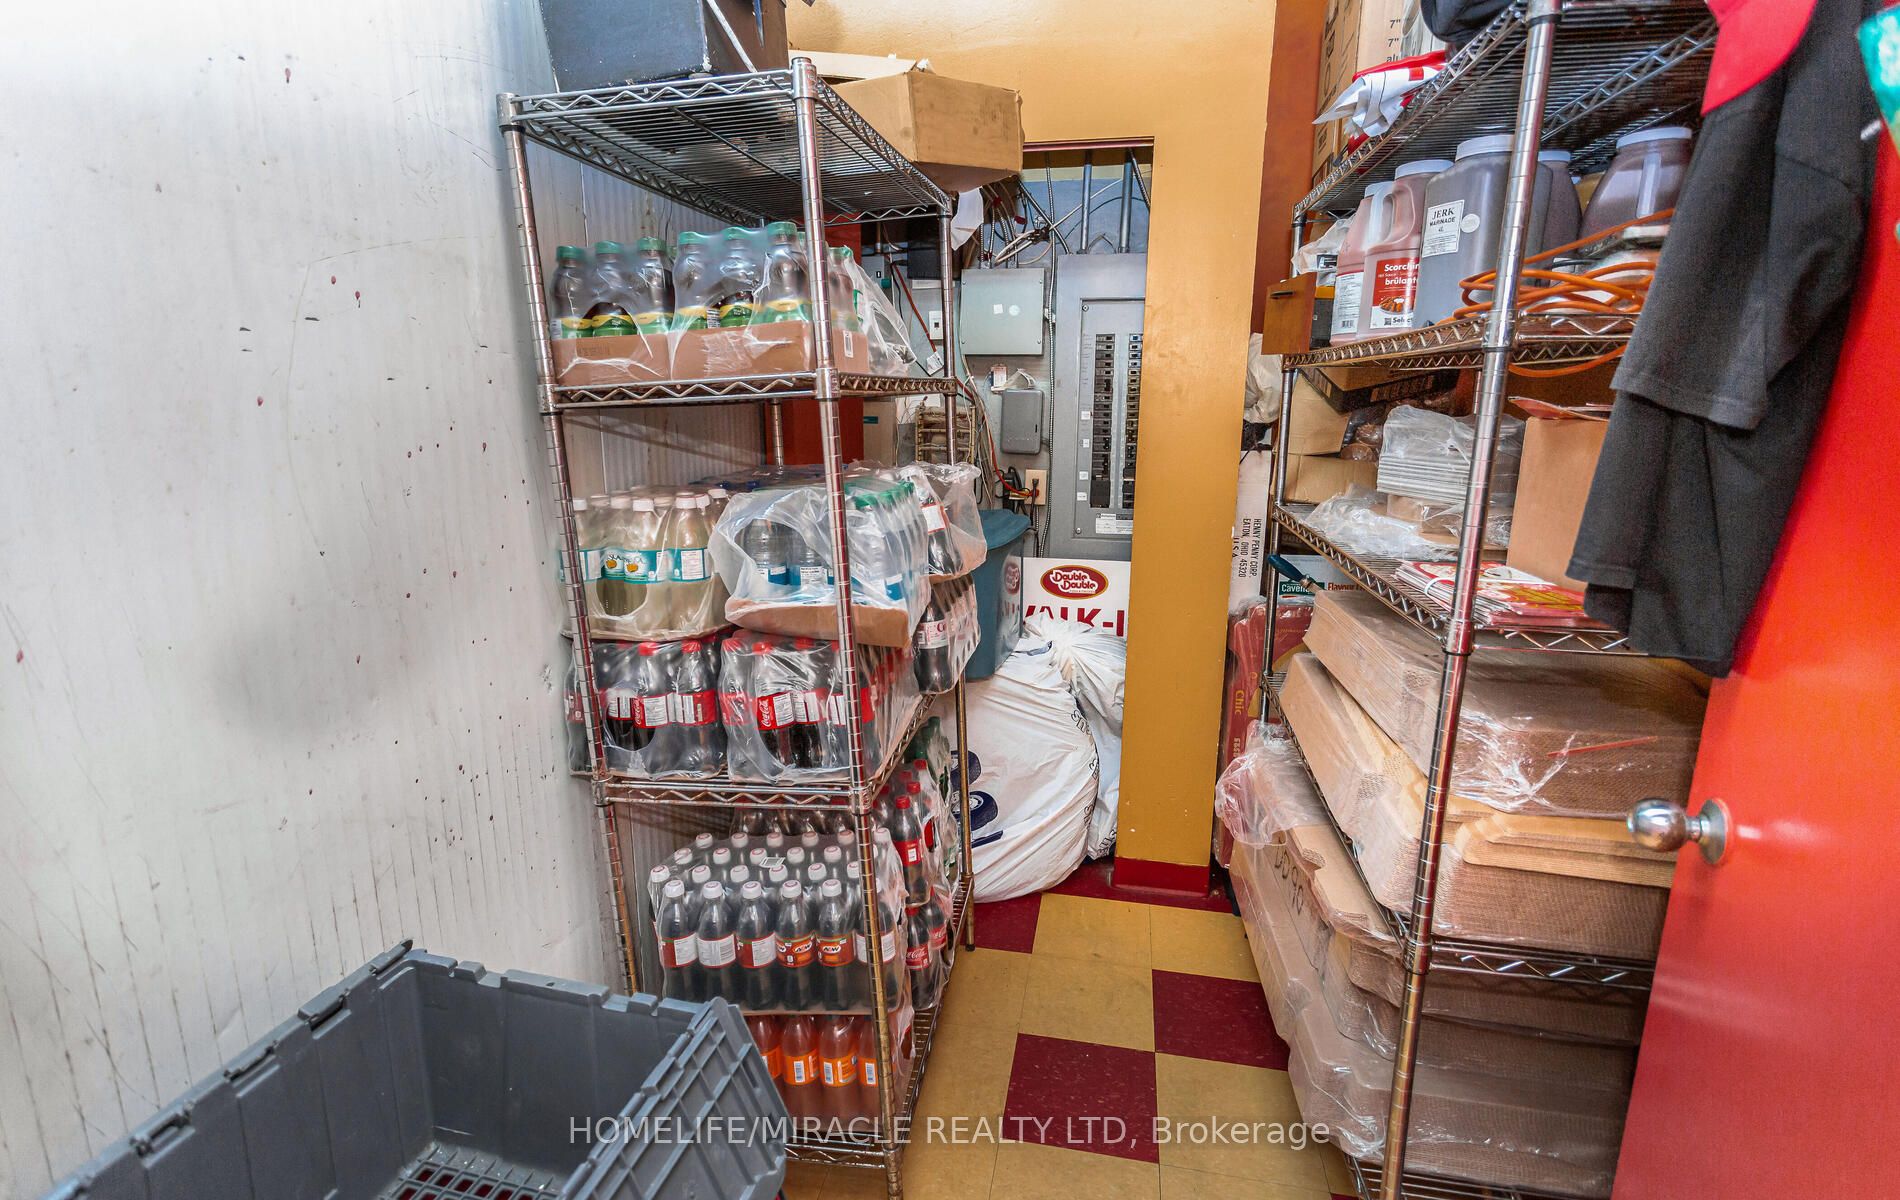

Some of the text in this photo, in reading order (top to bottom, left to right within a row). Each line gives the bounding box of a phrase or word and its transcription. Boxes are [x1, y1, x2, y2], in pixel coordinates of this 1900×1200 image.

[1432, 207, 1454, 220] JERK
[1430, 217, 1455, 226] MARINADE
[1385, 276, 1418, 286] brûlant
[1238, 518, 1251, 578] EATON, OHIO 45320
[1249, 518, 1261, 578] HENNY PENNY CORP.
[1052, 571, 1088, 583] Double
[1060, 580, 1096, 591] Double
